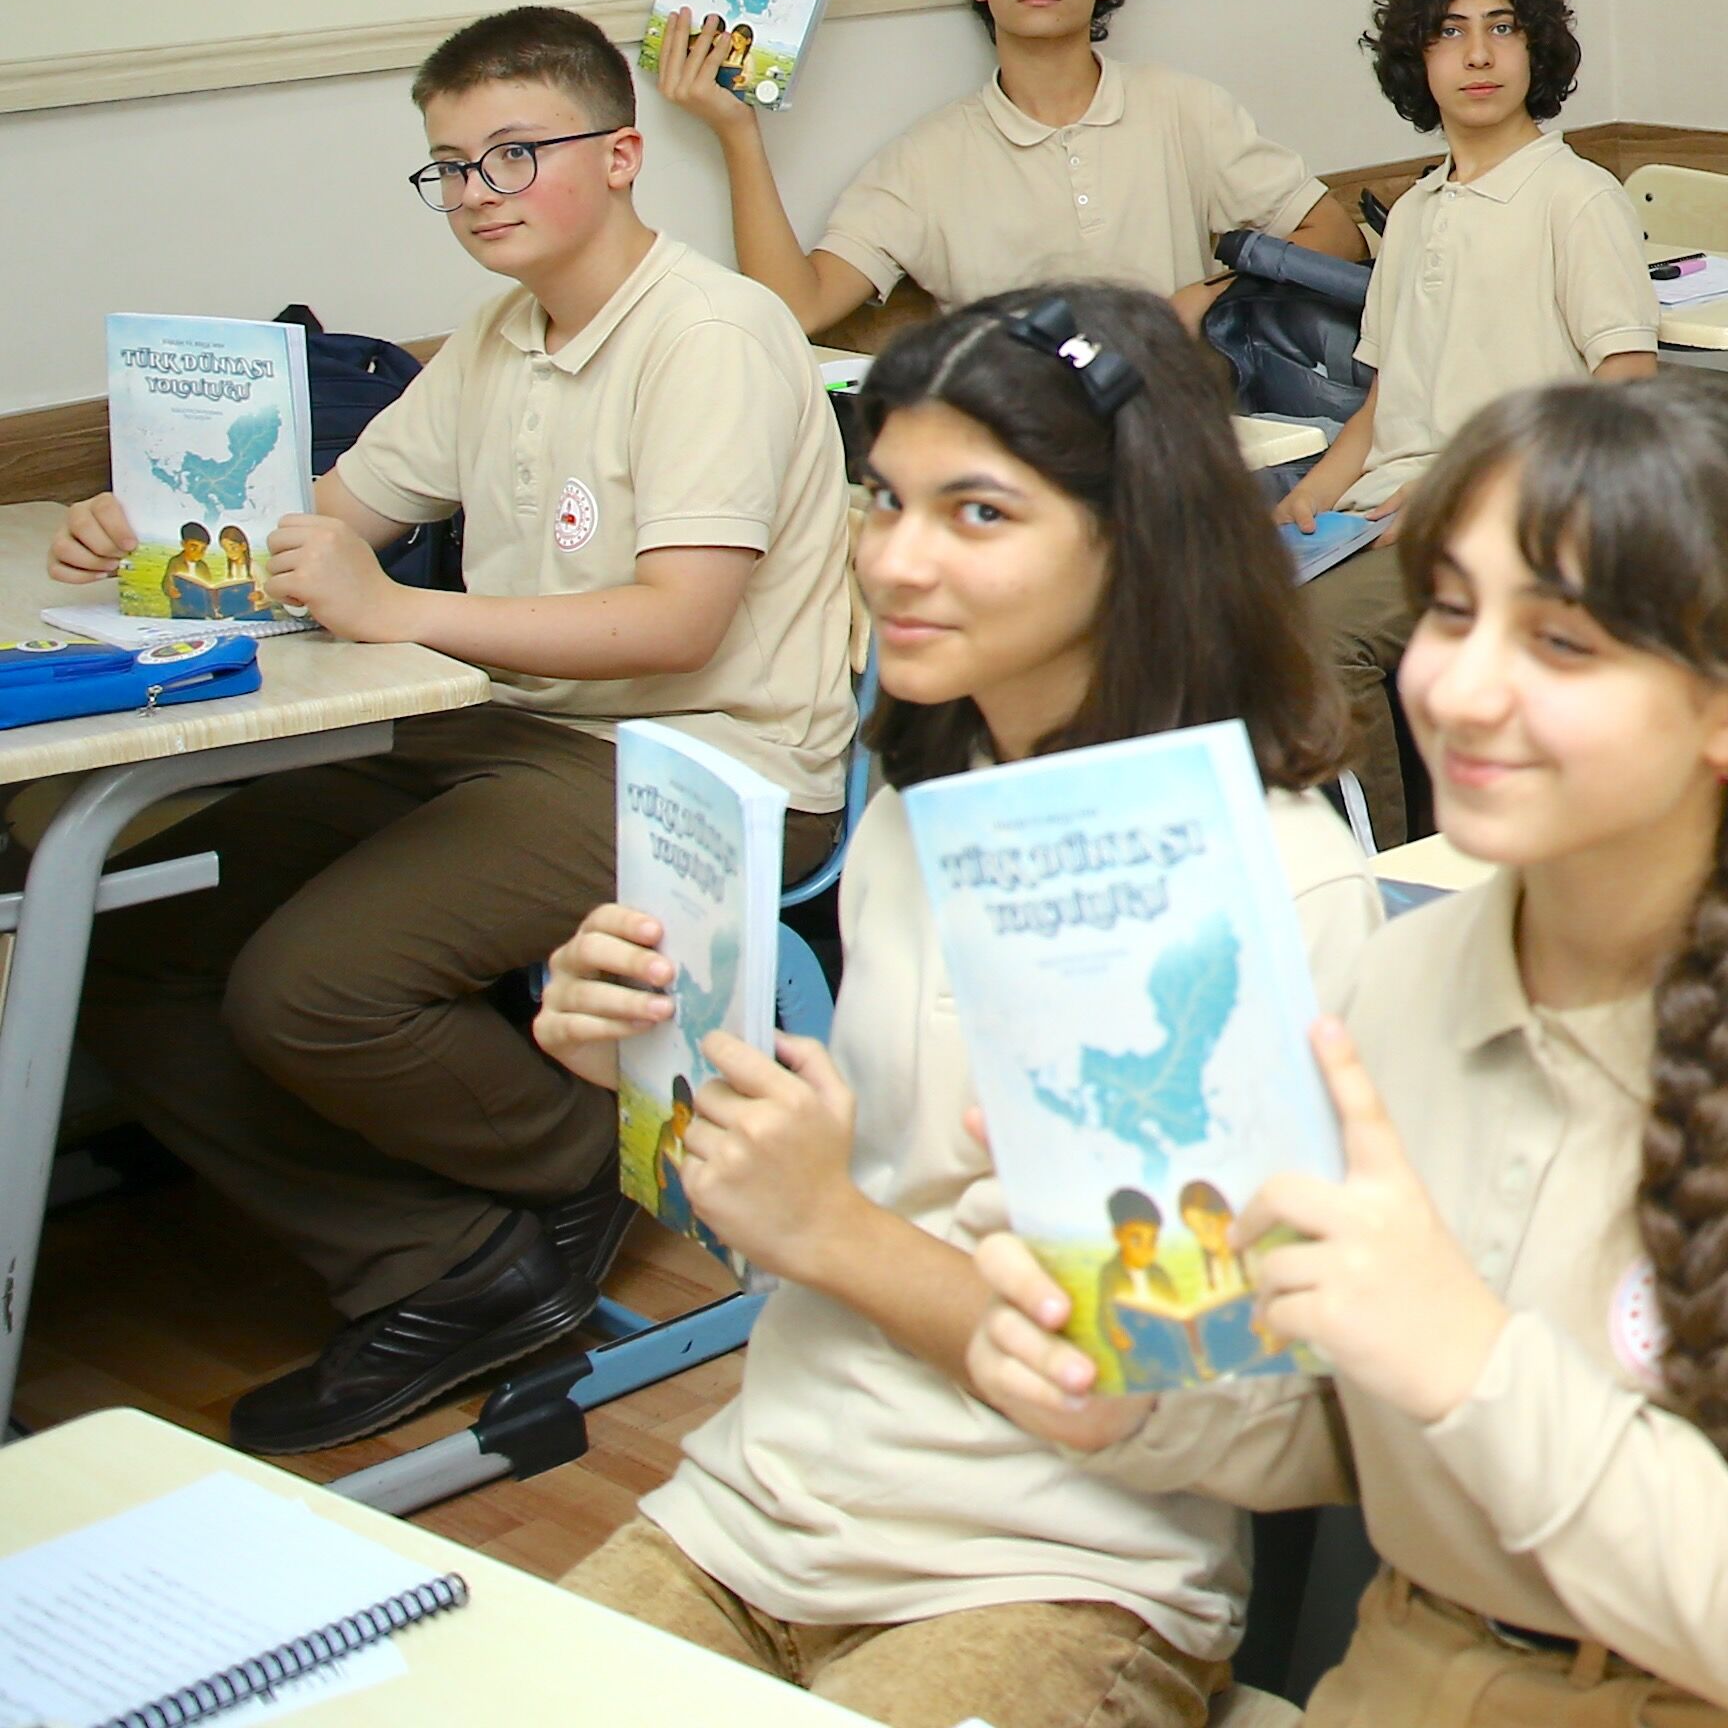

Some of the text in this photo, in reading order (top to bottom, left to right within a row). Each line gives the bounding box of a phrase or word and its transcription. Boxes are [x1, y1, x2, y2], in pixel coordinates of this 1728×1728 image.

[121, 348, 274, 380] TÜRK DÜNYASI
[145, 376, 251, 402] YOLCULUĞU
